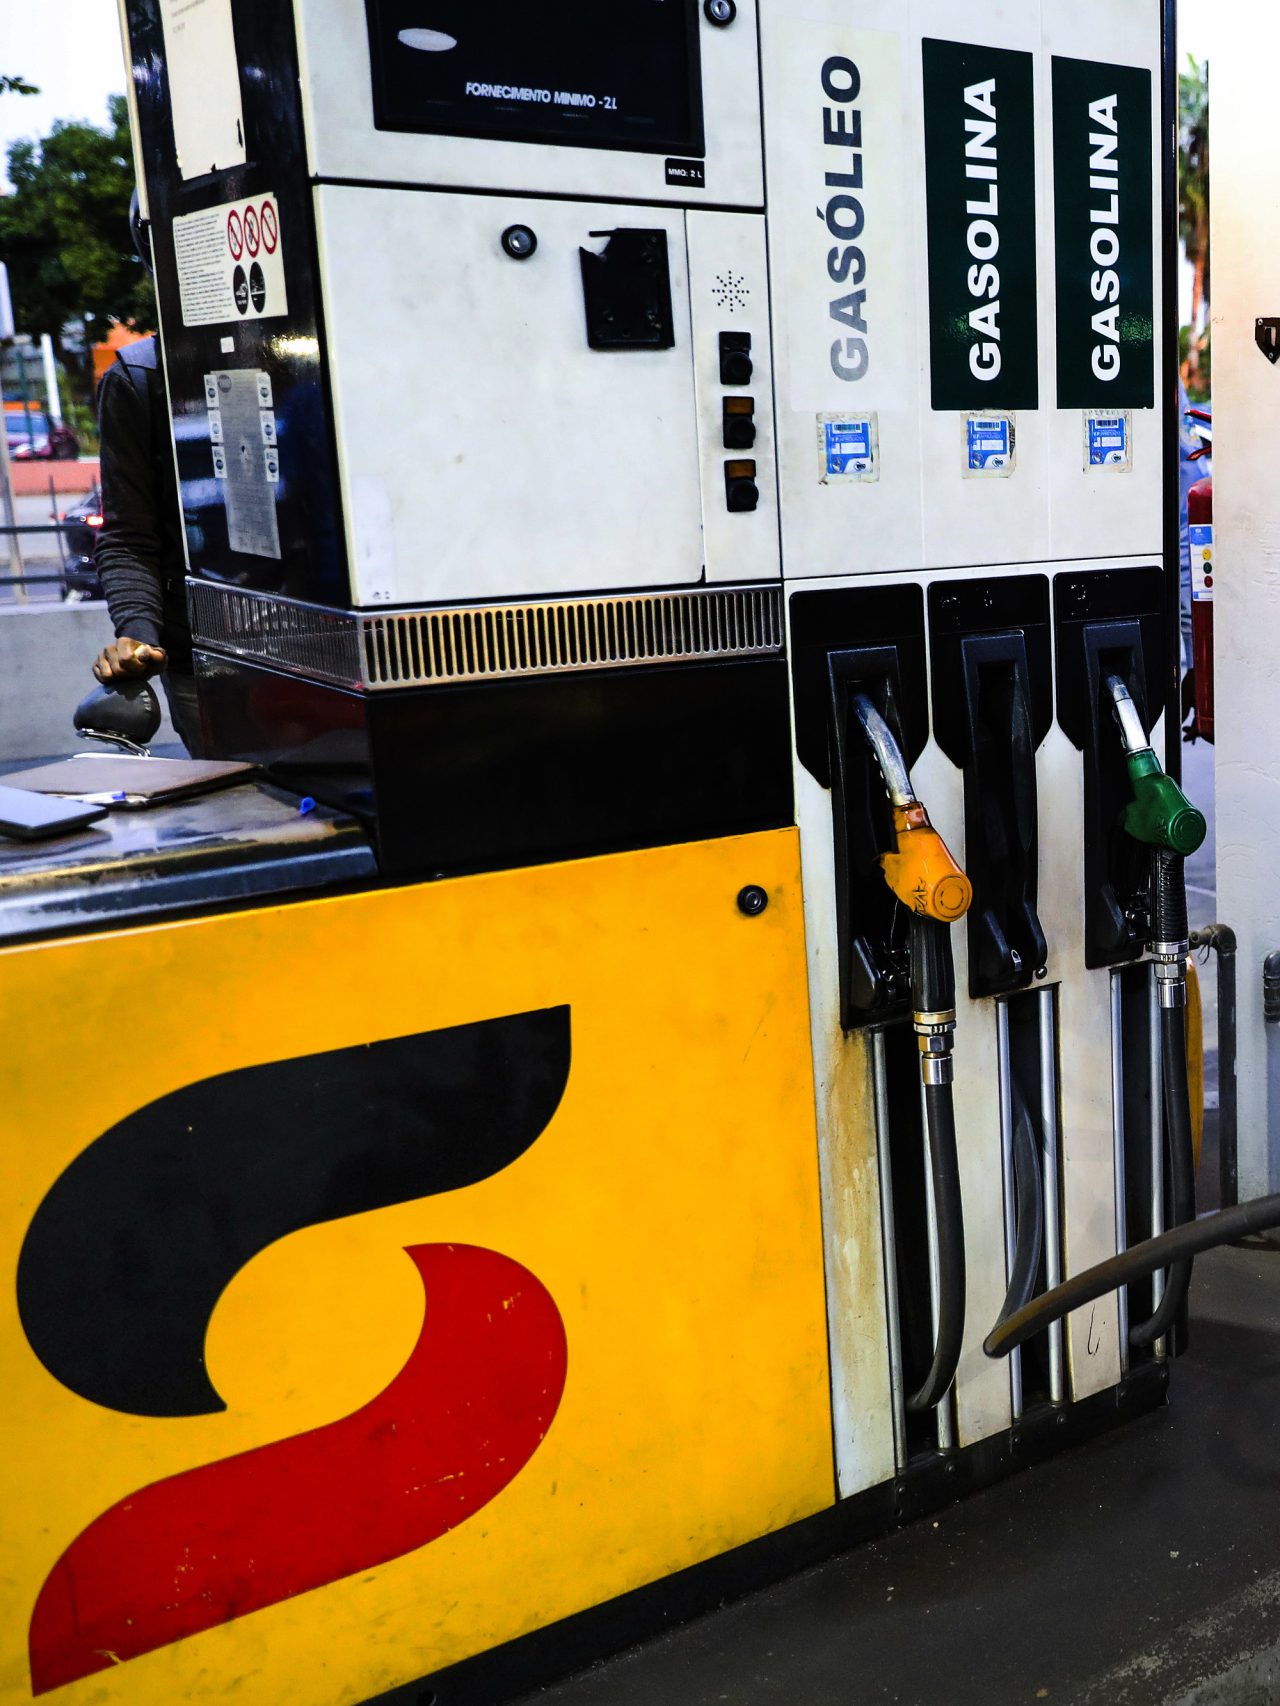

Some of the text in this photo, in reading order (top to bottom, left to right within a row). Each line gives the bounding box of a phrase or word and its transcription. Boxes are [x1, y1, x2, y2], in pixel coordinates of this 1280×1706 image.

[465, 81, 551, 103] FORNECIMENTO
[553, 90, 596, 108] MINIMO
[668, 168, 689, 177] MMQ:
[690, 169, 696, 178] 2
[816, 55, 869, 382] GASÓLEO
[963, 78, 1002, 382] GASOLINA
[1088, 93, 1121, 383] GASOLINA
